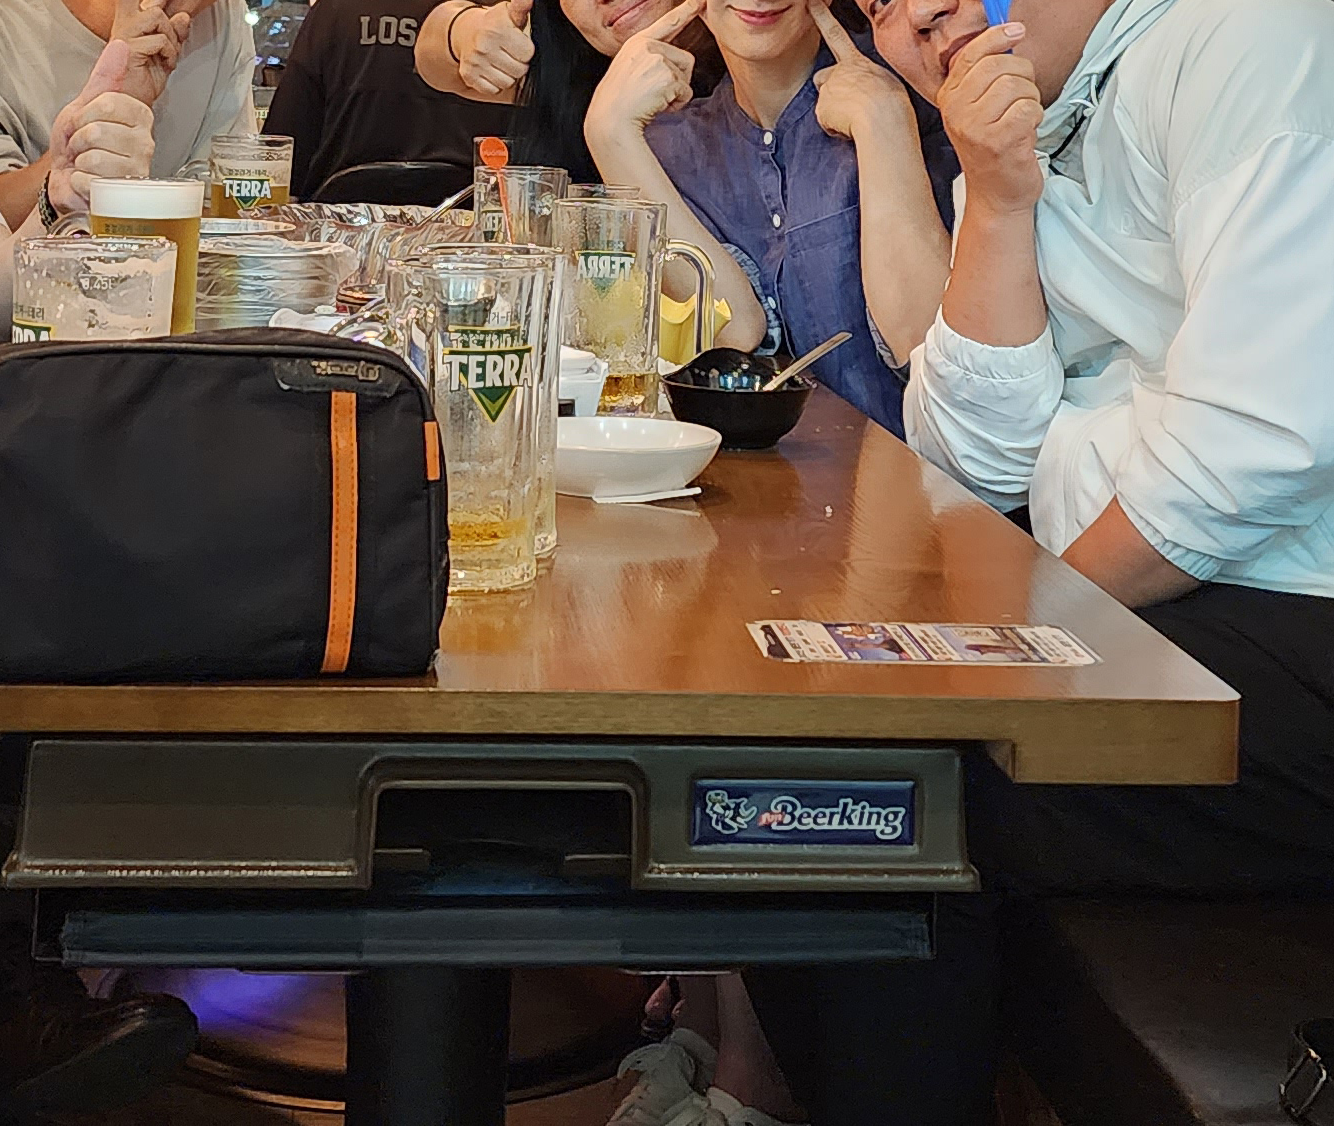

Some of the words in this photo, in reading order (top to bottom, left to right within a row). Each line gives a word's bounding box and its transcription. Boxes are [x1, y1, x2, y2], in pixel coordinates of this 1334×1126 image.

[223, 180, 272, 199] TERRA
[443, 354, 533, 392] TERRA
[770, 796, 906, 840] Beerking
